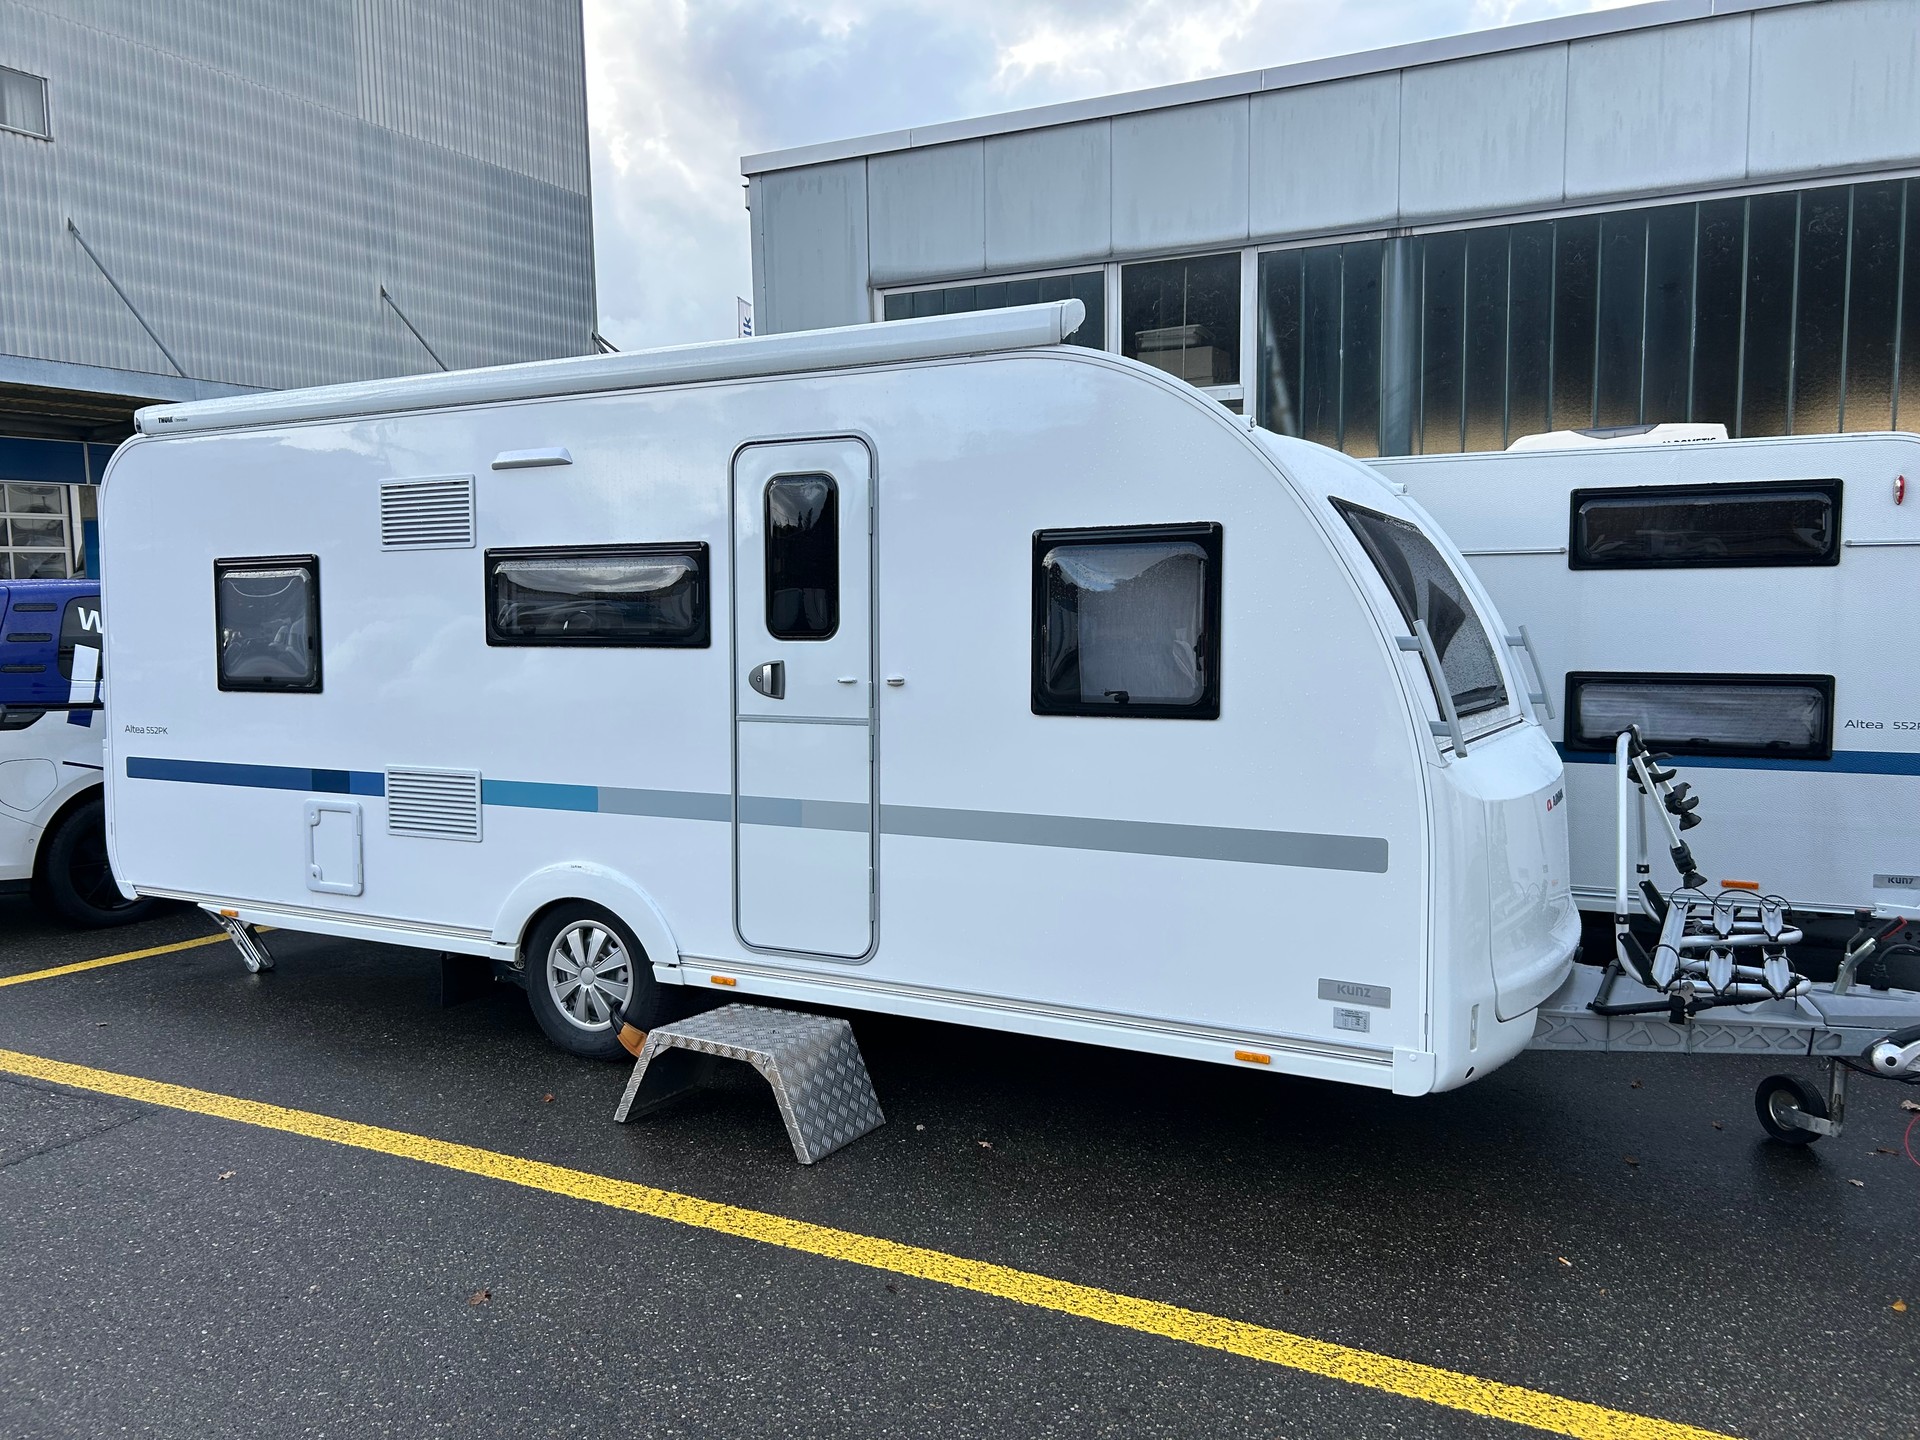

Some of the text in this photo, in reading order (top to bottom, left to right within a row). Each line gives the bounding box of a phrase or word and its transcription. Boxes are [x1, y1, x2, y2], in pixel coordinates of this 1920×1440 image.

[125, 724, 169, 735] Altea 552PK
[1844, 719, 1884, 730] Altea
